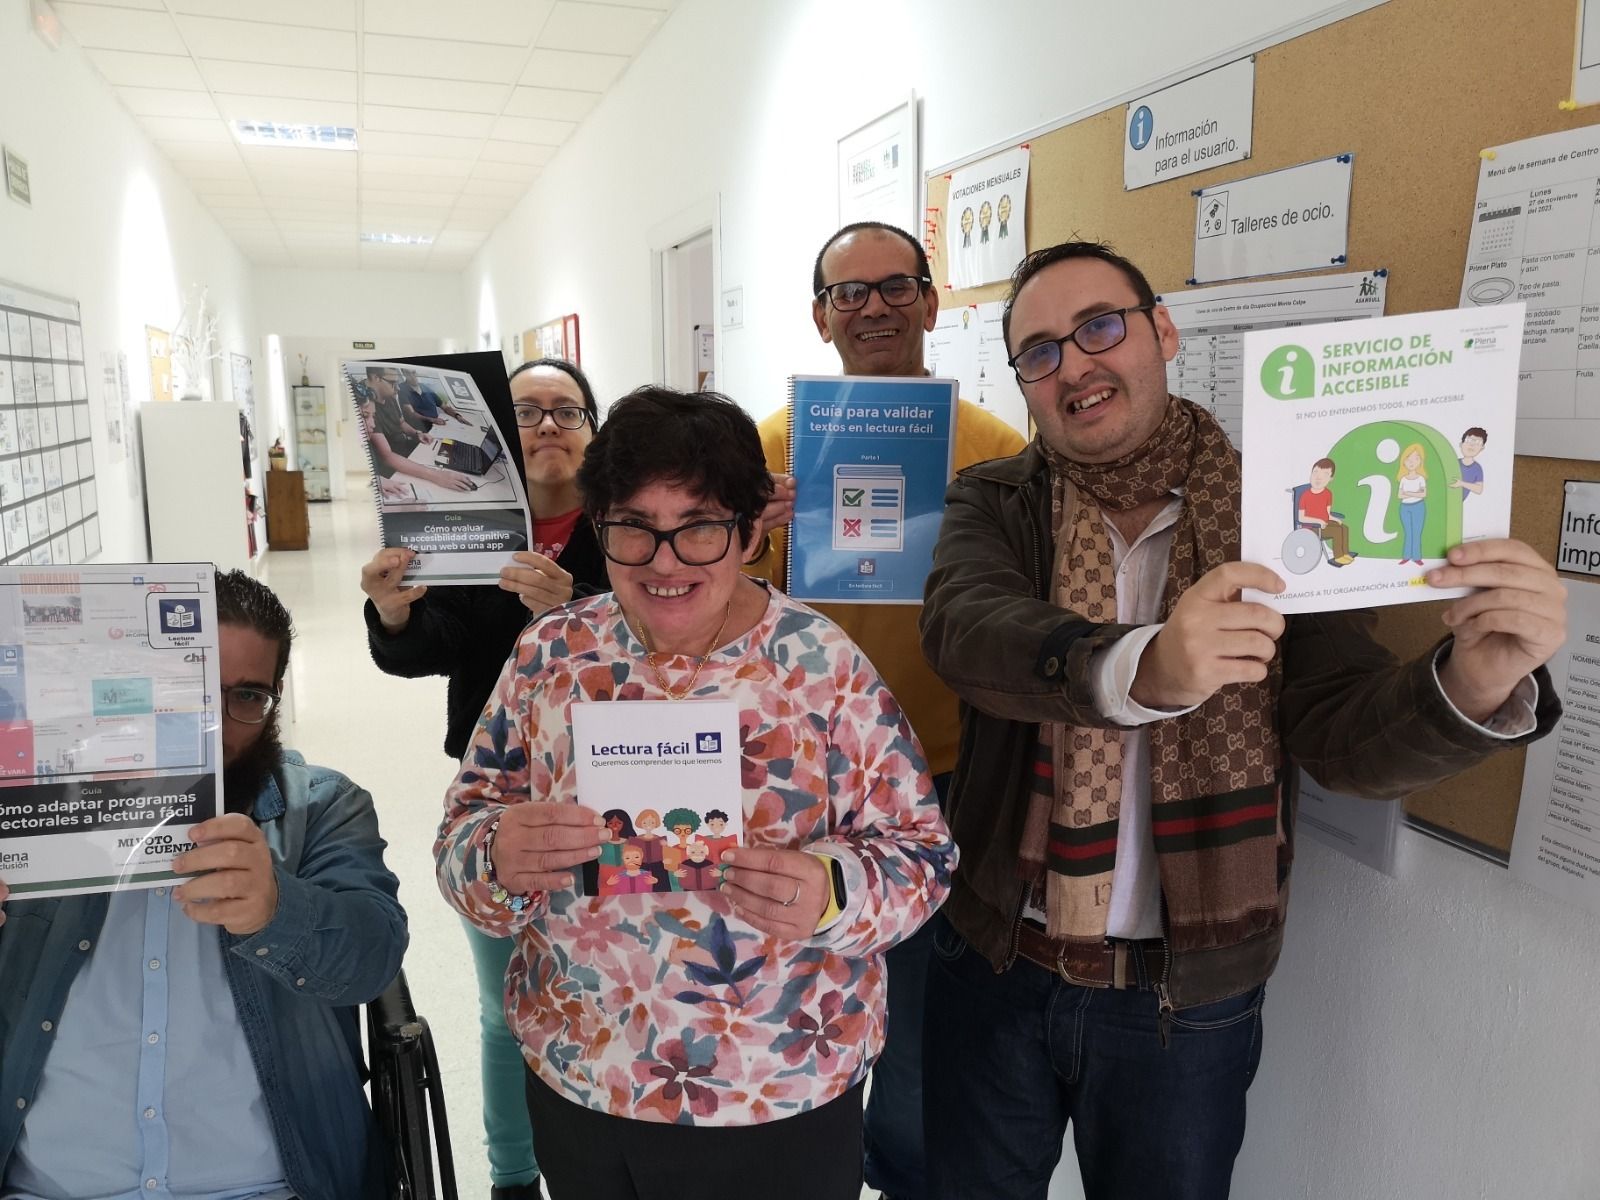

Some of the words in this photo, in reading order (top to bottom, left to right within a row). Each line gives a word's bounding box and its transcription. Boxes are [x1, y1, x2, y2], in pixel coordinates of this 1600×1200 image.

[1155, 119, 1218, 150] Información
[1155, 156, 1178, 176] para
[1181, 148, 1191, 165] el
[1194, 137, 1239, 162] usuario.
[1488, 168, 1506, 177] Menú
[1508, 164, 1516, 173] de
[1526, 156, 1556, 168] semana
[1558, 153, 1568, 162] de
[1570, 147, 1599, 158] Centro
[952, 180, 986, 200] VOTACIONES
[986, 168, 1022, 188] MENSUALES
[1530, 188, 1552, 198] Lunes
[1546, 192, 1578, 204] noviembre
[1231, 214, 1278, 235] Talleres
[1282, 208, 1298, 226] de
[1302, 202, 1334, 222] ocio.
[1468, 264, 1490, 272] Primer
[1490, 261, 1508, 270] Plato
[1522, 256, 1538, 264] Pasta
[1519, 284, 1532, 292] Tipo
[1578, 333, 1593, 342] Tipo
[1322, 336, 1404, 360] SERVICIO
[1410, 334, 1432, 348] DE
[1322, 348, 1453, 378] INFORMACIÓN
[1322, 374, 1410, 396] ACCESIBLE
[810, 404, 842, 417] Guía
[847, 407, 880, 420] para
[884, 406, 934, 420] validar
[1304, 411, 1317, 419] NO
[1318, 410, 1328, 418] LO
[1329, 405, 1376, 416] ENTENDEMOS
[1420, 398, 1428, 406] ES
[1430, 394, 1464, 404] ACCESIBLE
[810, 422, 846, 432] textos
[848, 424, 862, 433] en
[866, 423, 906, 433] lectura
[909, 422, 934, 434] fácil
[424, 524, 450, 533] Cómo
[452, 524, 484, 532] evaluar
[410, 532, 467, 542] accesibilidad
[468, 532, 510, 542] cognitiva
[439, 542, 458, 550] web
[486, 542, 504, 550] app
[1274, 591, 1314, 600] AYUDAMOS
[1323, 588, 1332, 596] TU
[1332, 582, 1389, 595] ORGANIZACIÓN
[1398, 580, 1409, 588] SER
[591, 743, 653, 756] Lectura
[657, 742, 690, 757] fácil
[591, 759, 629, 767] Queremos
[630, 759, 673, 767] comprender
[81, 788, 102, 796] Guía
[37, 800, 104, 816] adaptar
[108, 792, 197, 810] programas
[0, 814, 79, 830] ectorales
[83, 815, 93, 824] a
[98, 809, 155, 824] lectura
[159, 804, 194, 818] fácil
[118, 838, 134, 848] MI
[144, 842, 198, 855] CUENTA
